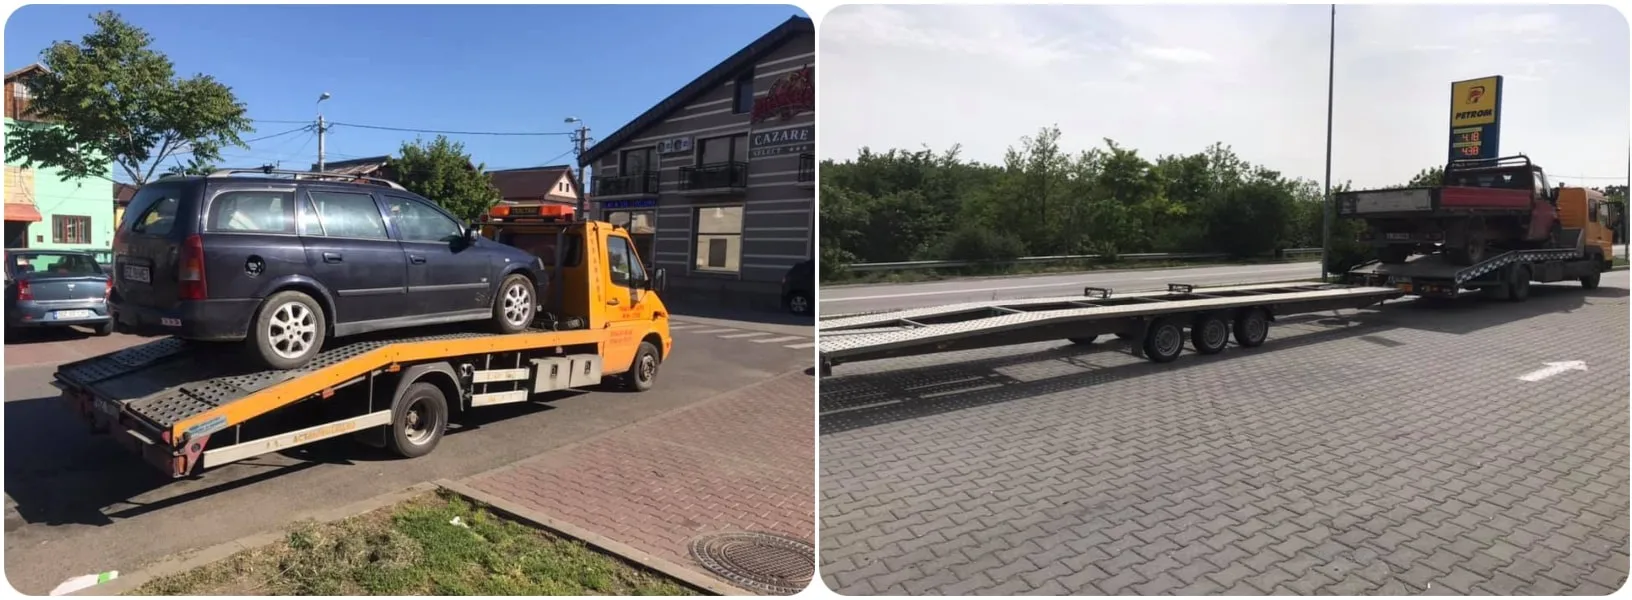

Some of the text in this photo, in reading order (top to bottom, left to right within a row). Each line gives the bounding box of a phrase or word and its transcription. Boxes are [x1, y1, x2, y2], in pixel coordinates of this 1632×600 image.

[1455, 109, 1492, 120] PETROM
[754, 129, 809, 146] CAZARE
[753, 147, 782, 156] SELECT
